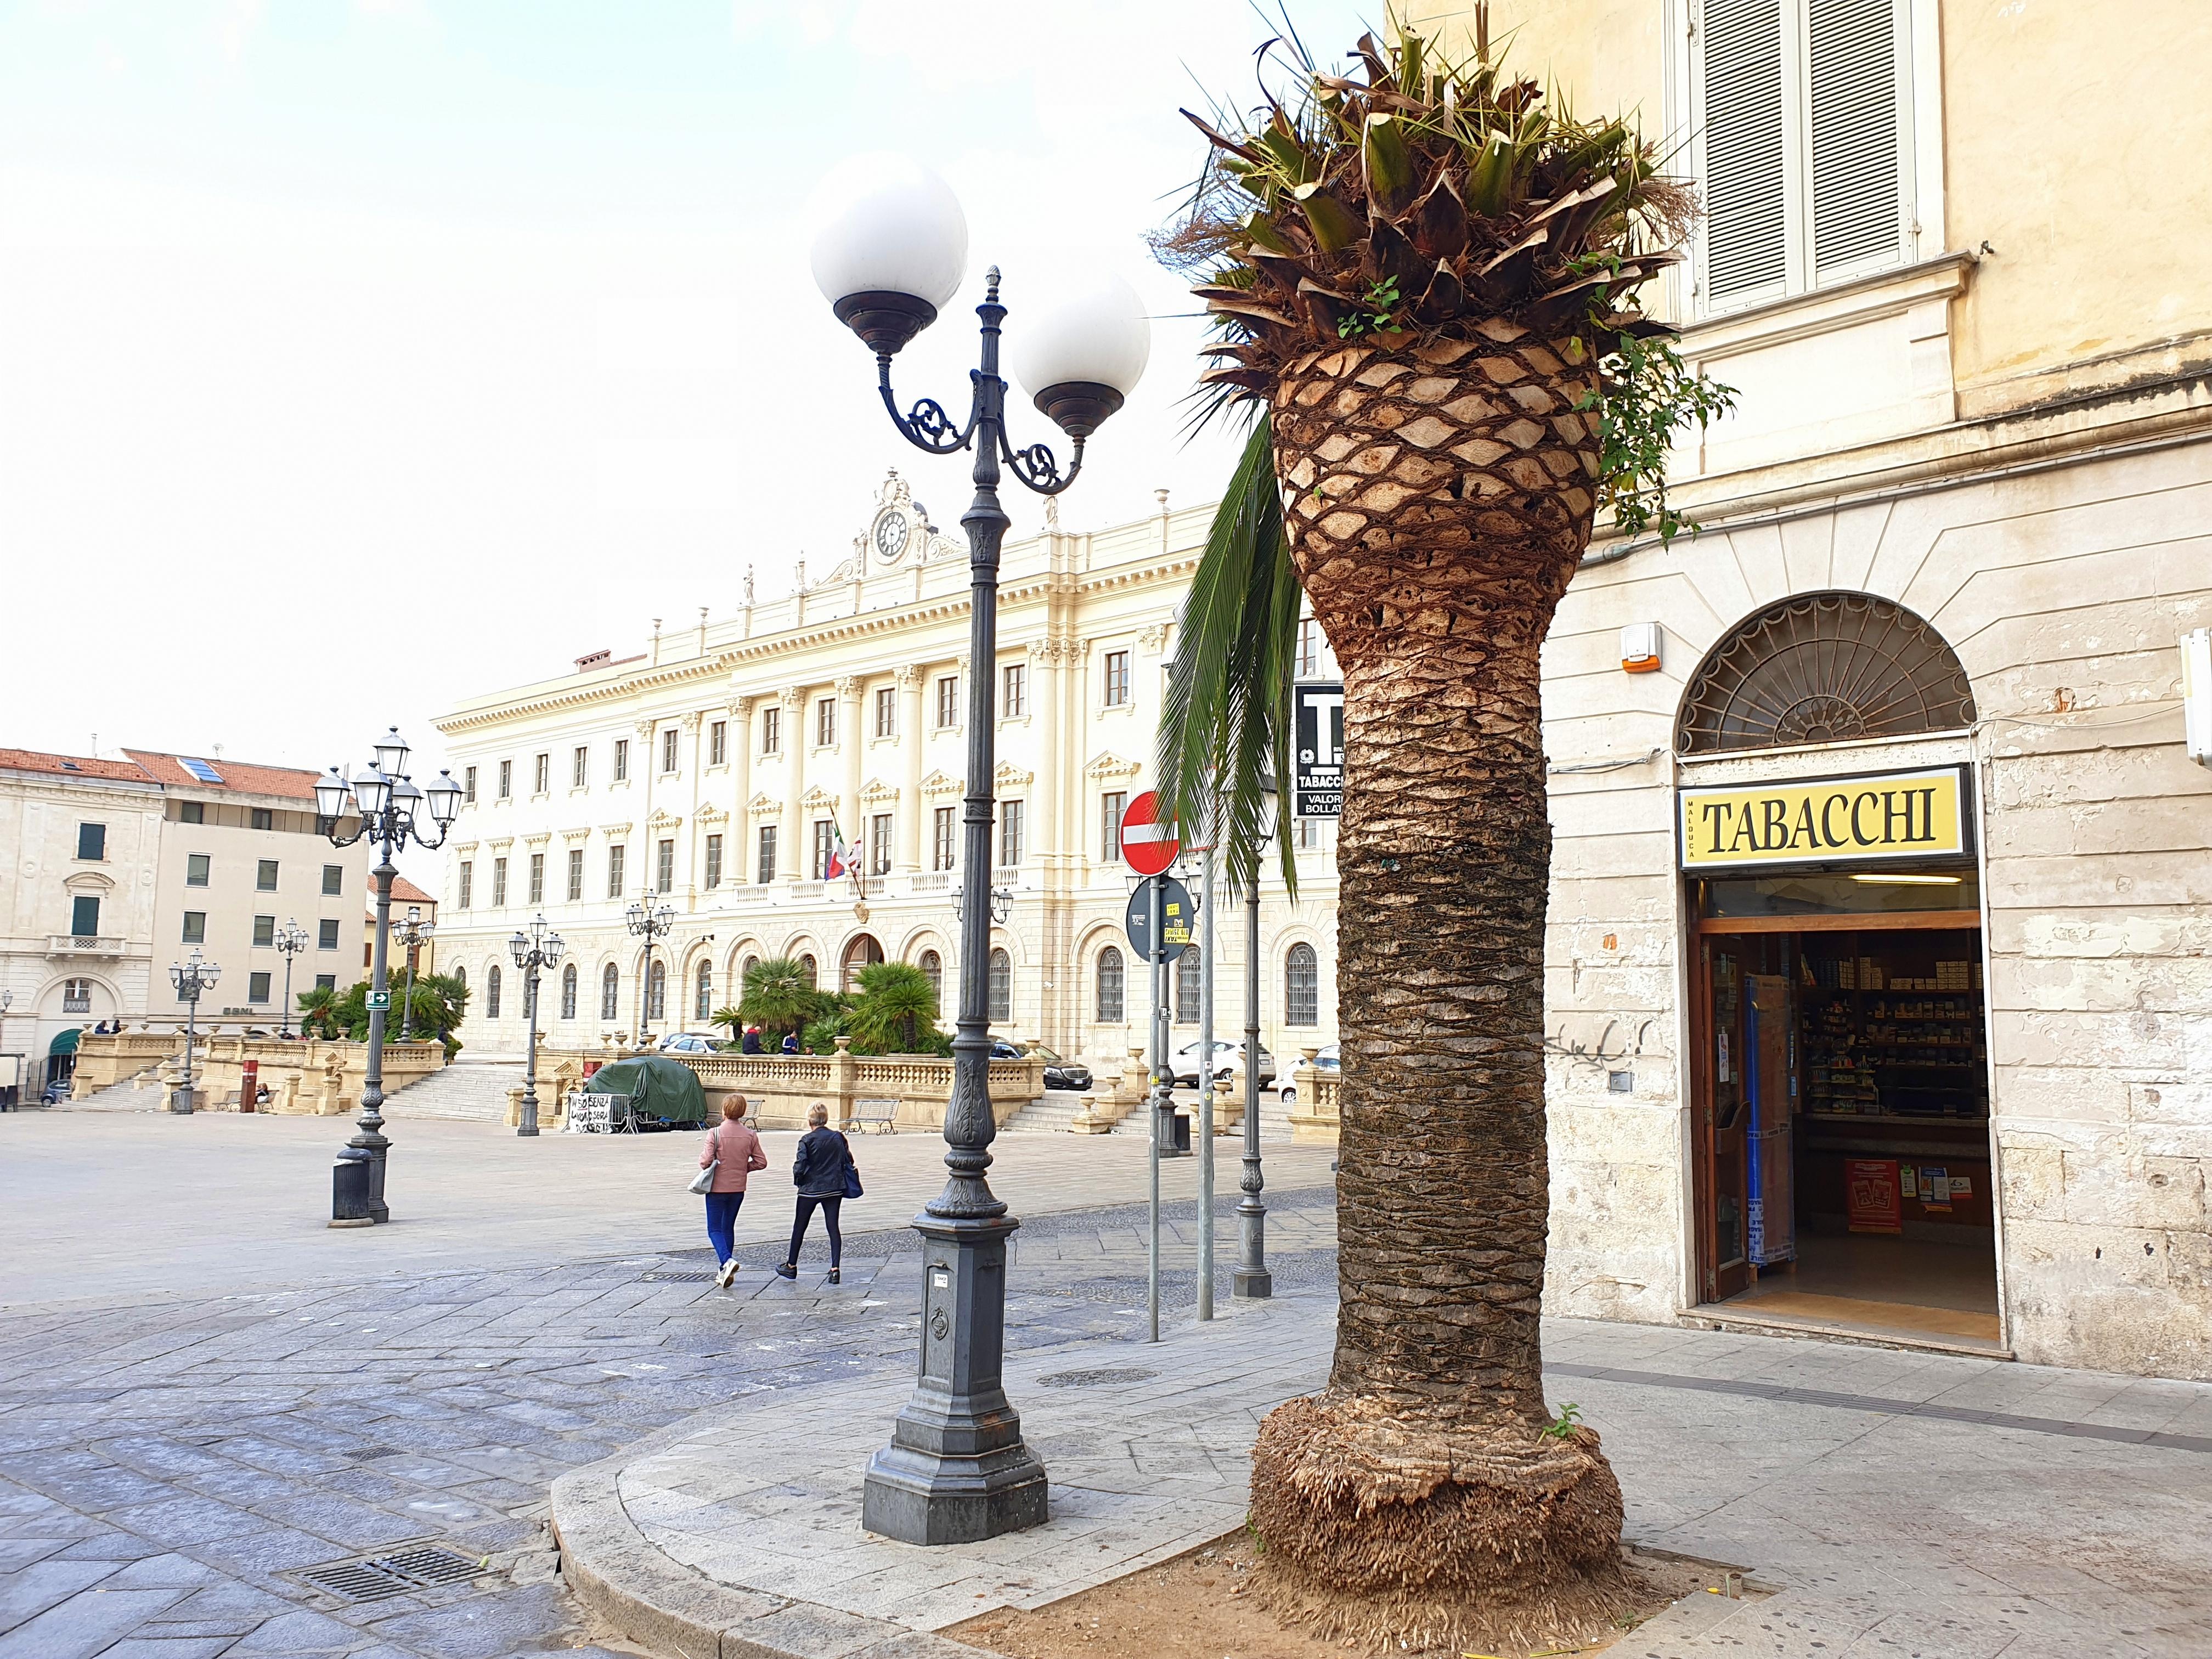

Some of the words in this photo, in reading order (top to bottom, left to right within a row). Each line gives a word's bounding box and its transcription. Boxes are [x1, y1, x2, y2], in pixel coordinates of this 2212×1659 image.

[1299, 775, 1344, 788] TABACC
[1305, 804, 1342, 813] BOLLAT
[1702, 788, 1937, 853] TABACCHI
[589, 1096, 609, 1108] SENZA
